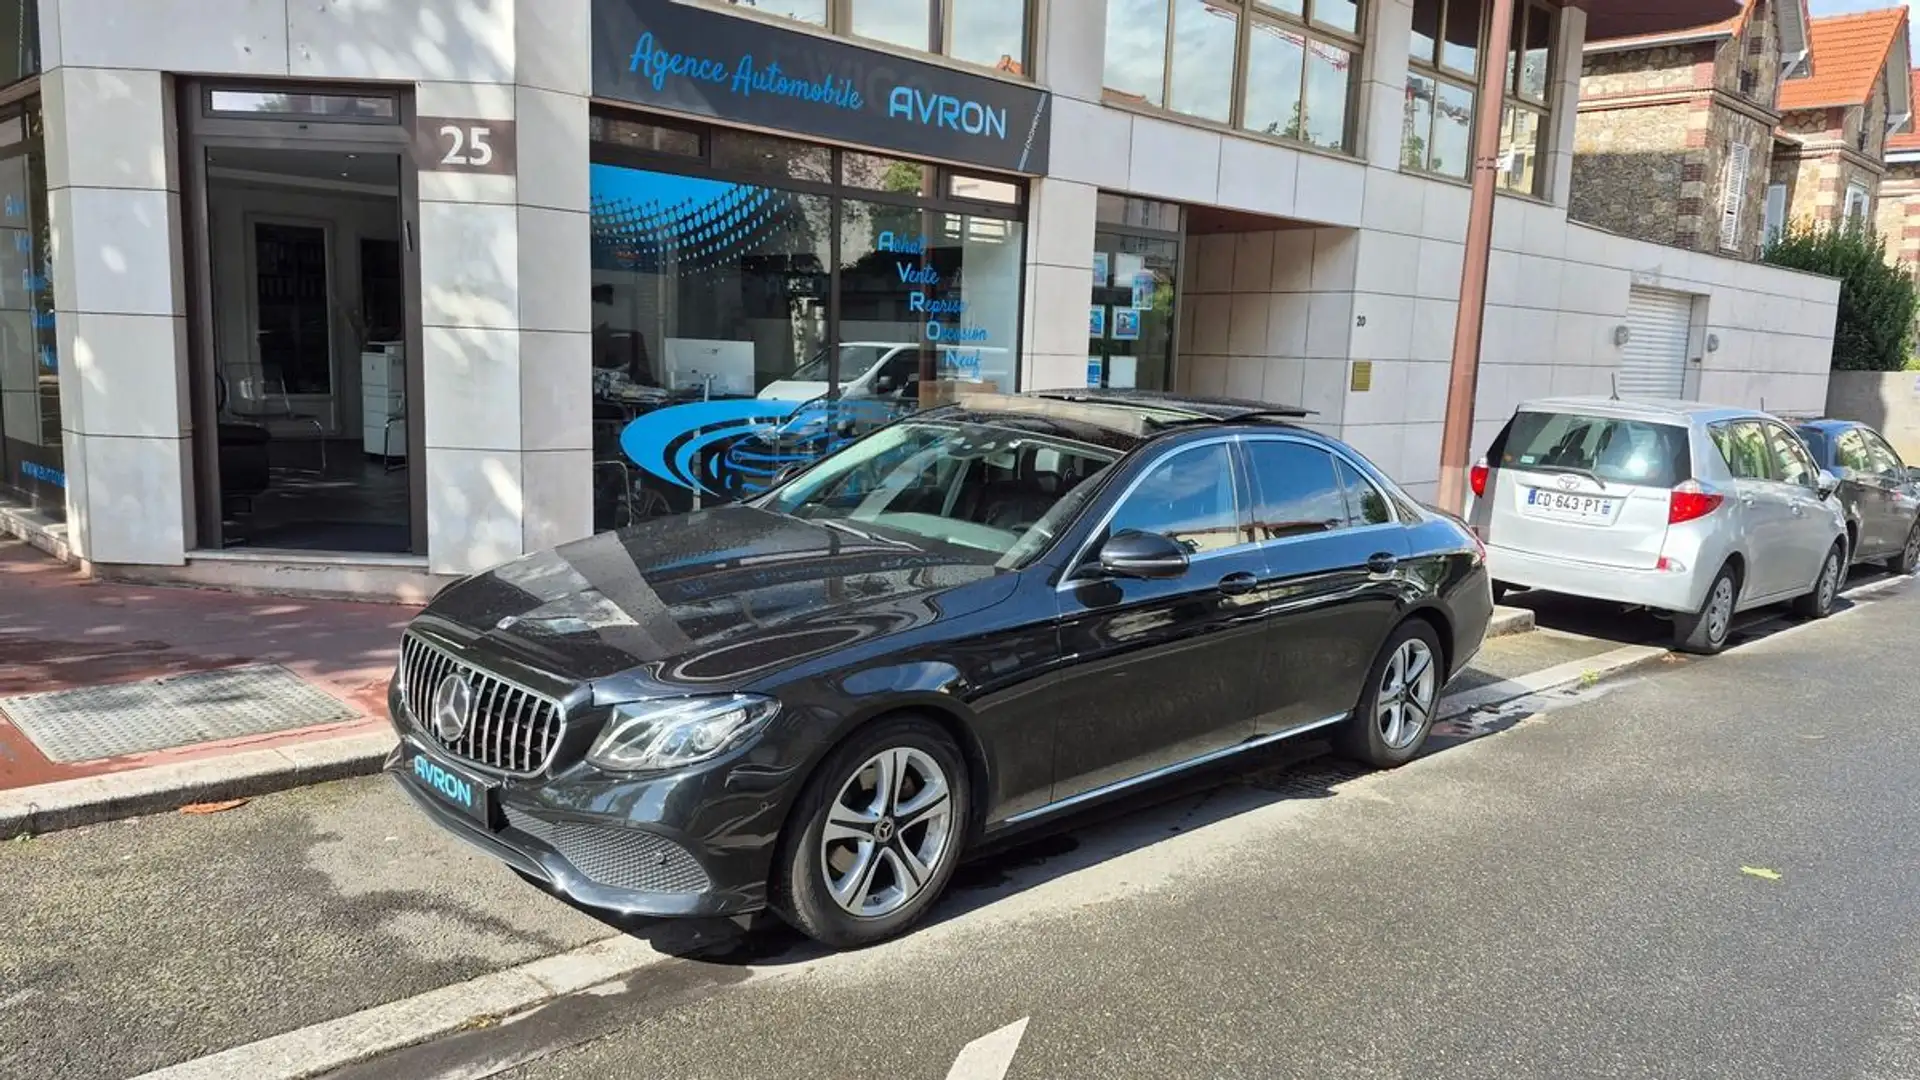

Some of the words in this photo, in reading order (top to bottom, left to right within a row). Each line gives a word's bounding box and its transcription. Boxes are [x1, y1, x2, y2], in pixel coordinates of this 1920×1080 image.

[629, 31, 728, 90] Agence
[731, 54, 862, 111] Automobile
[889, 86, 1006, 139] AVRON
[440, 126, 492, 165] 25
[878, 230, 927, 254] Achat
[897, 261, 939, 284] Vente
[414, 754, 471, 807] AVRON
